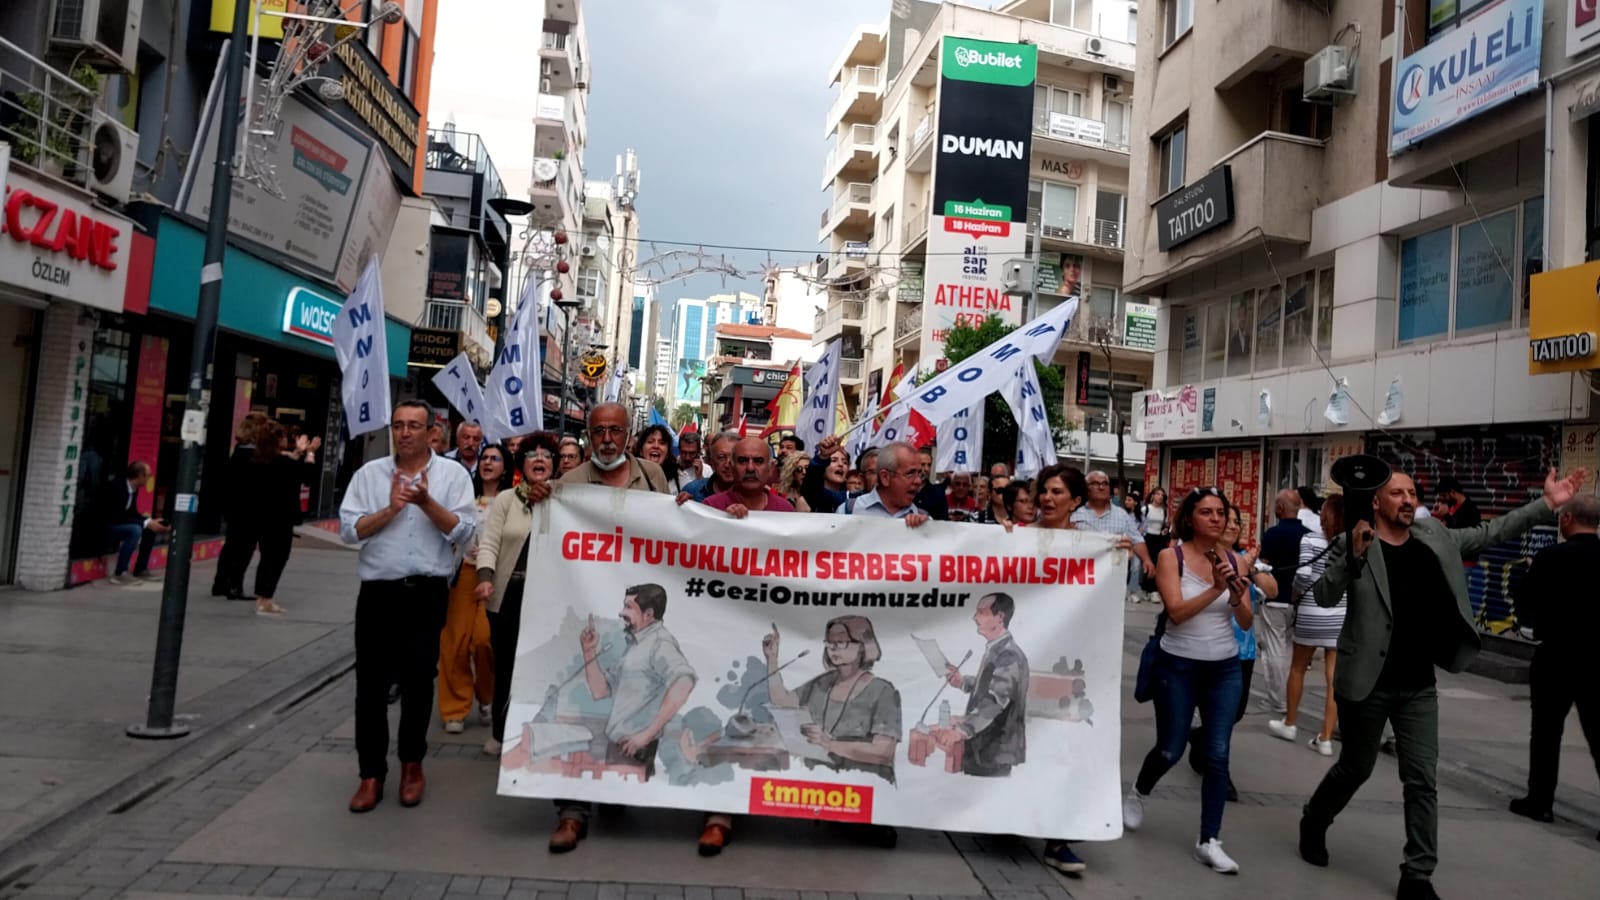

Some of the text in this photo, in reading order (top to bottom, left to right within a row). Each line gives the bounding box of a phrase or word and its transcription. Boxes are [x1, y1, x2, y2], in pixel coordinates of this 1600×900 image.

[968, 51, 1022, 69] Bubilet
[942, 134, 1024, 160] DUMAN
[965, 205, 1002, 217] Haziran
[1168, 197, 1215, 241] TATTOO
[964, 221, 1001, 233] Haziran
[32, 257, 70, 286] ÖZLEM
[935, 284, 1011, 312] ATHENA
[1531, 332, 1590, 361] TATTOO
[561, 525, 1096, 586] GEZİ TUTUKLULARI SERBEST BIRAKILSIN!
[685, 577, 970, 609] #GeziOnurumuzdur
[762, 780, 861, 809] tmmob
